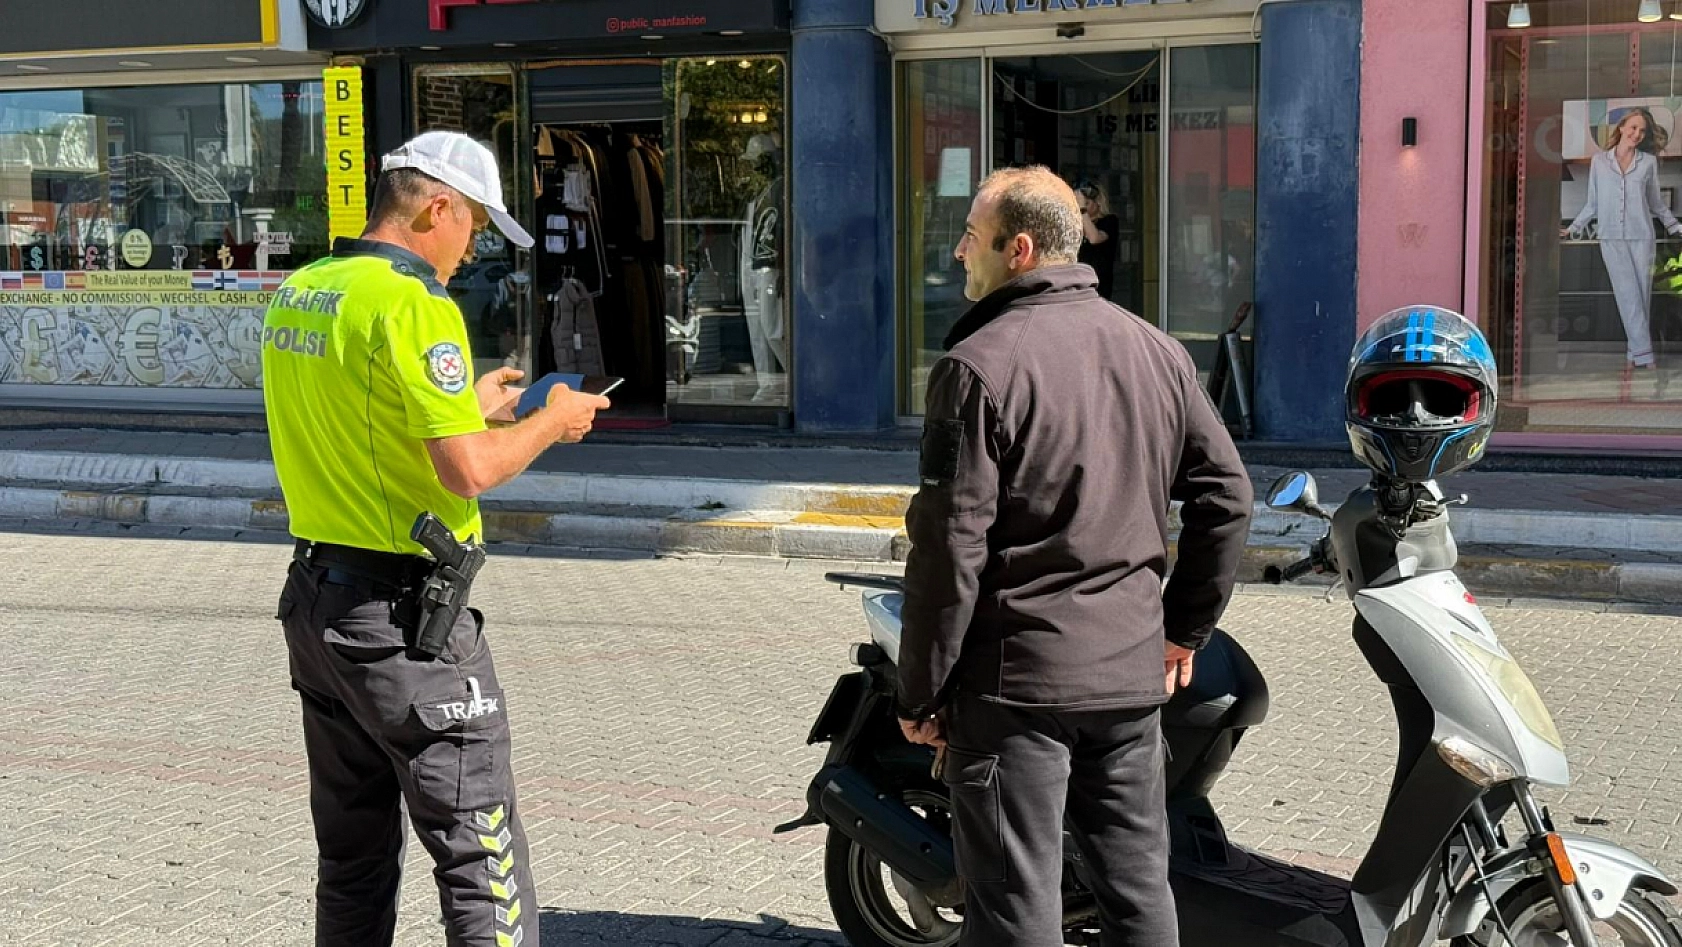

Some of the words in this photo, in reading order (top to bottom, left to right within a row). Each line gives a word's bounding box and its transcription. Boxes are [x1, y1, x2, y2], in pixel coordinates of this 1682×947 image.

[336, 79, 353, 206] BEST
[90, 274, 103, 285] The
[104, 274, 118, 285] Real
[120, 274, 138, 285] Value
[139, 273, 147, 285] of
[147, 276, 163, 287] your
[164, 274, 189, 287] Money
[0, 293, 54, 303] EXCHANGE
[62, 293, 78, 303] NO
[81, 293, 151, 303] COMMISSION
[160, 293, 209, 303] WECHSEL
[219, 293, 247, 303] CASH
